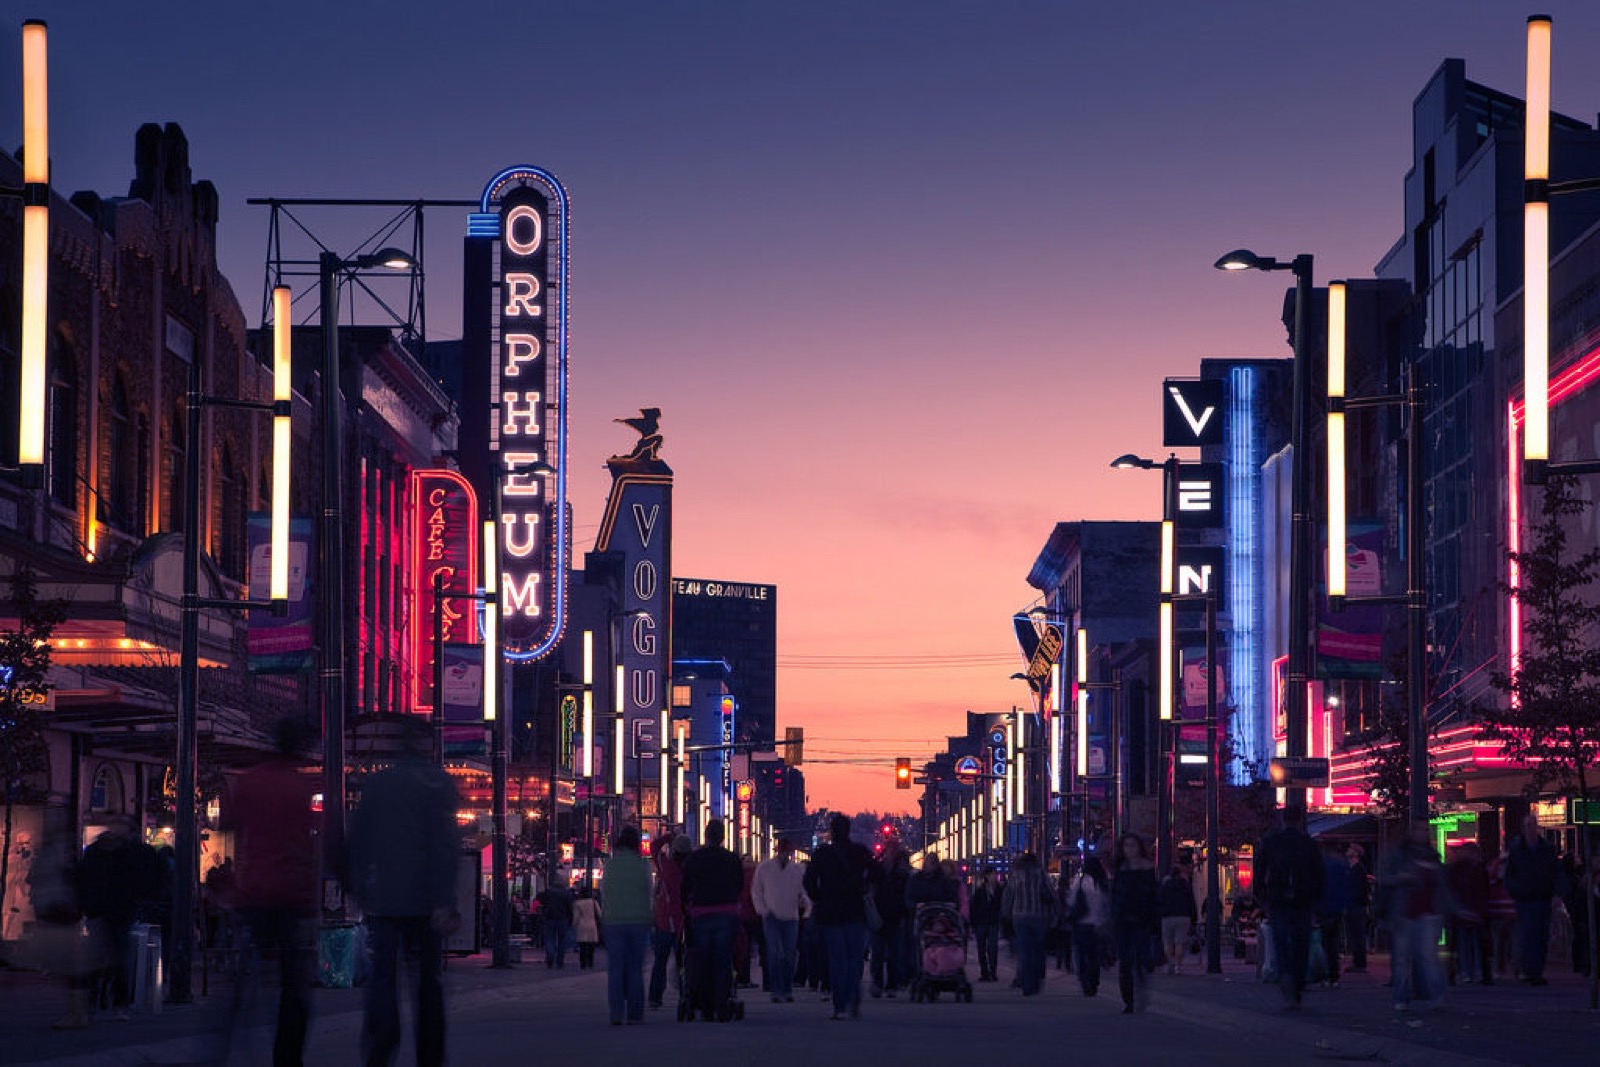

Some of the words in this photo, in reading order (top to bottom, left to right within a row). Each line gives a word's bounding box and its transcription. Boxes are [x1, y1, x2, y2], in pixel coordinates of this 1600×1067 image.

[502, 205, 541, 617] ORPHEUM
[631, 503, 660, 759] VOGUE
[705, 583, 767, 600] GRANVILLE
